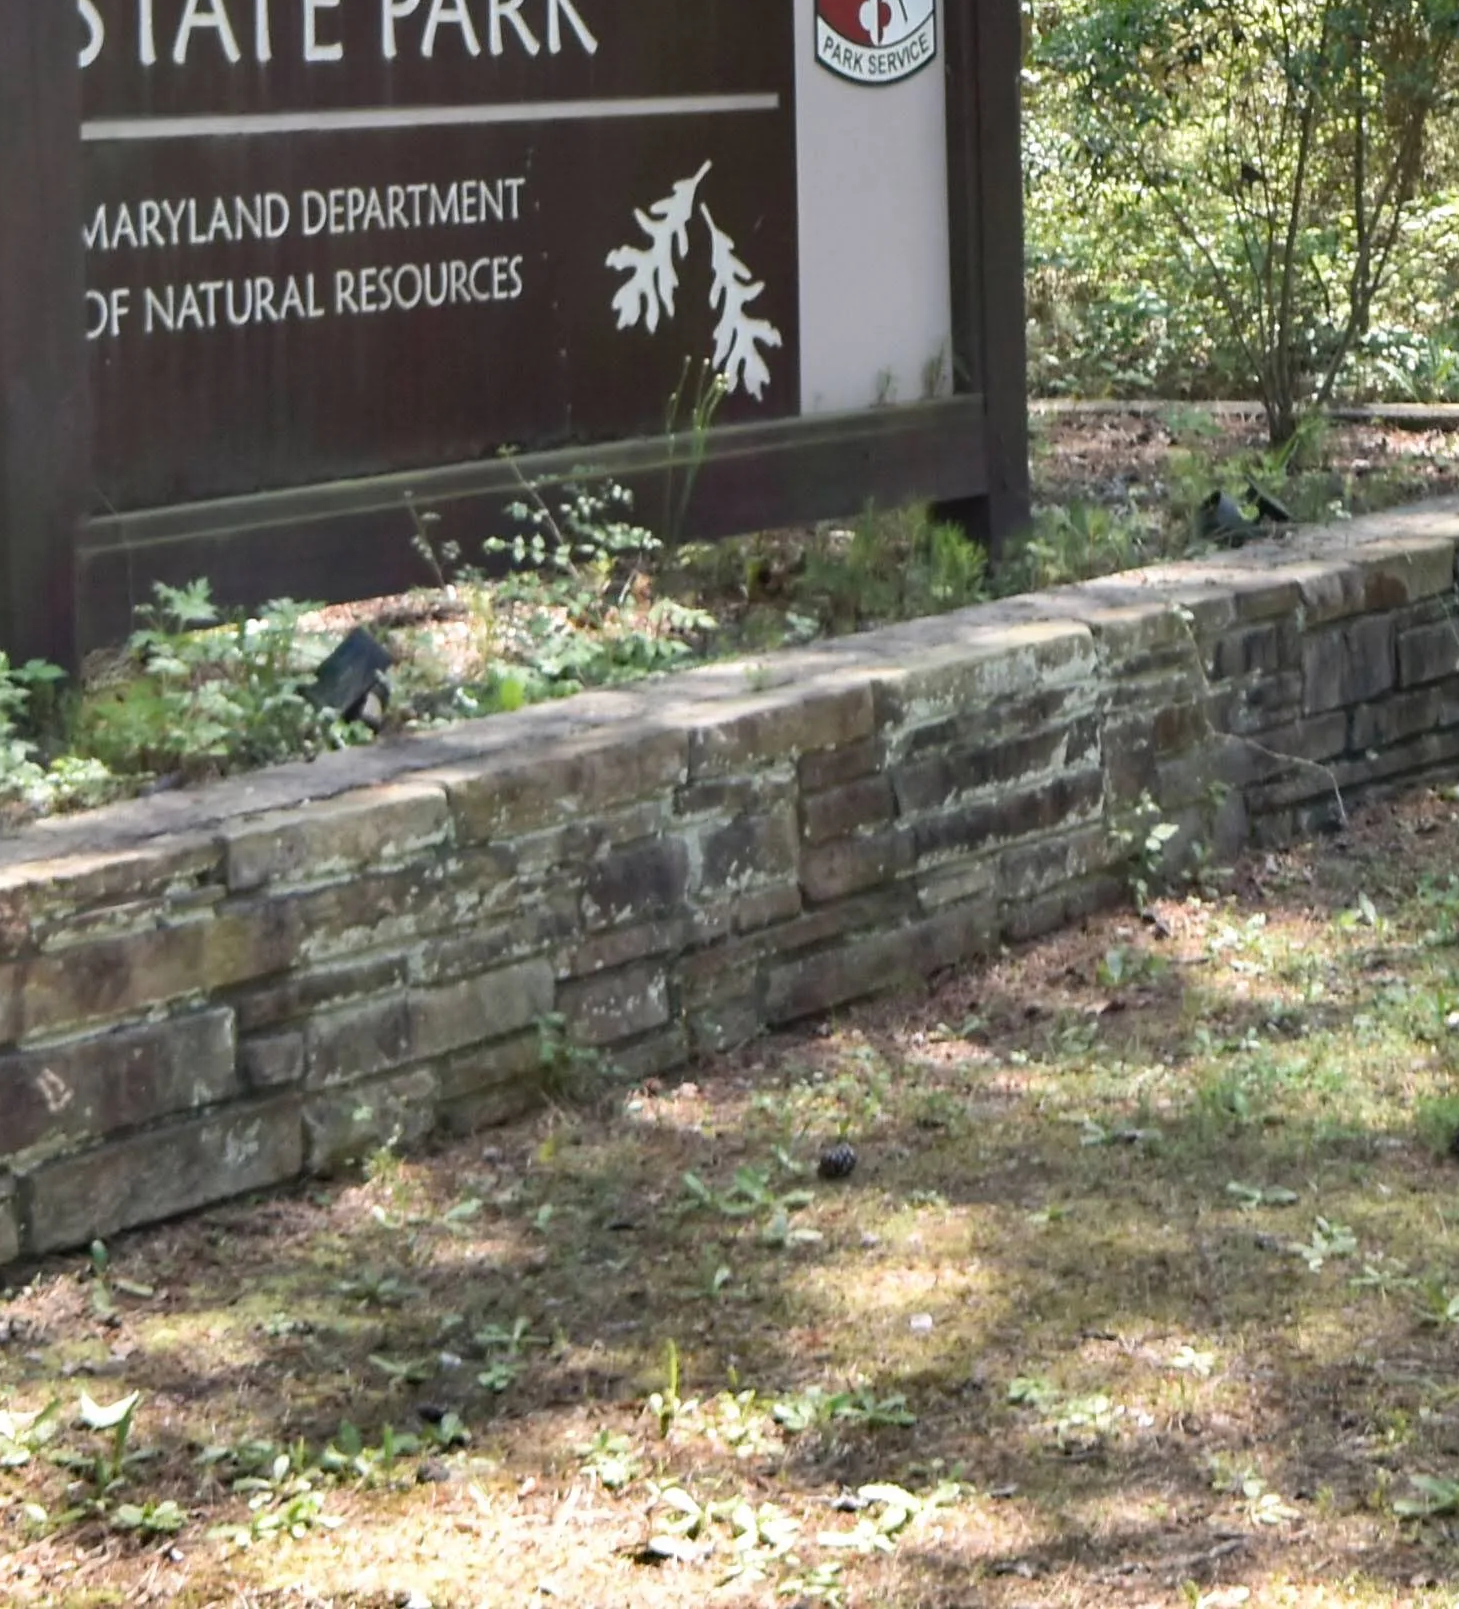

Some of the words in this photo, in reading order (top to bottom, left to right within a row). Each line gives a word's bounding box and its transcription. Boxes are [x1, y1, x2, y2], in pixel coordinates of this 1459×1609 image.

[823, 35, 864, 74] PARK
[867, 32, 930, 77] SERVICE
[302, 178, 526, 237] DEPARTMENT
[144, 273, 325, 333] NATURAL
[336, 256, 524, 315] RESOURCES
